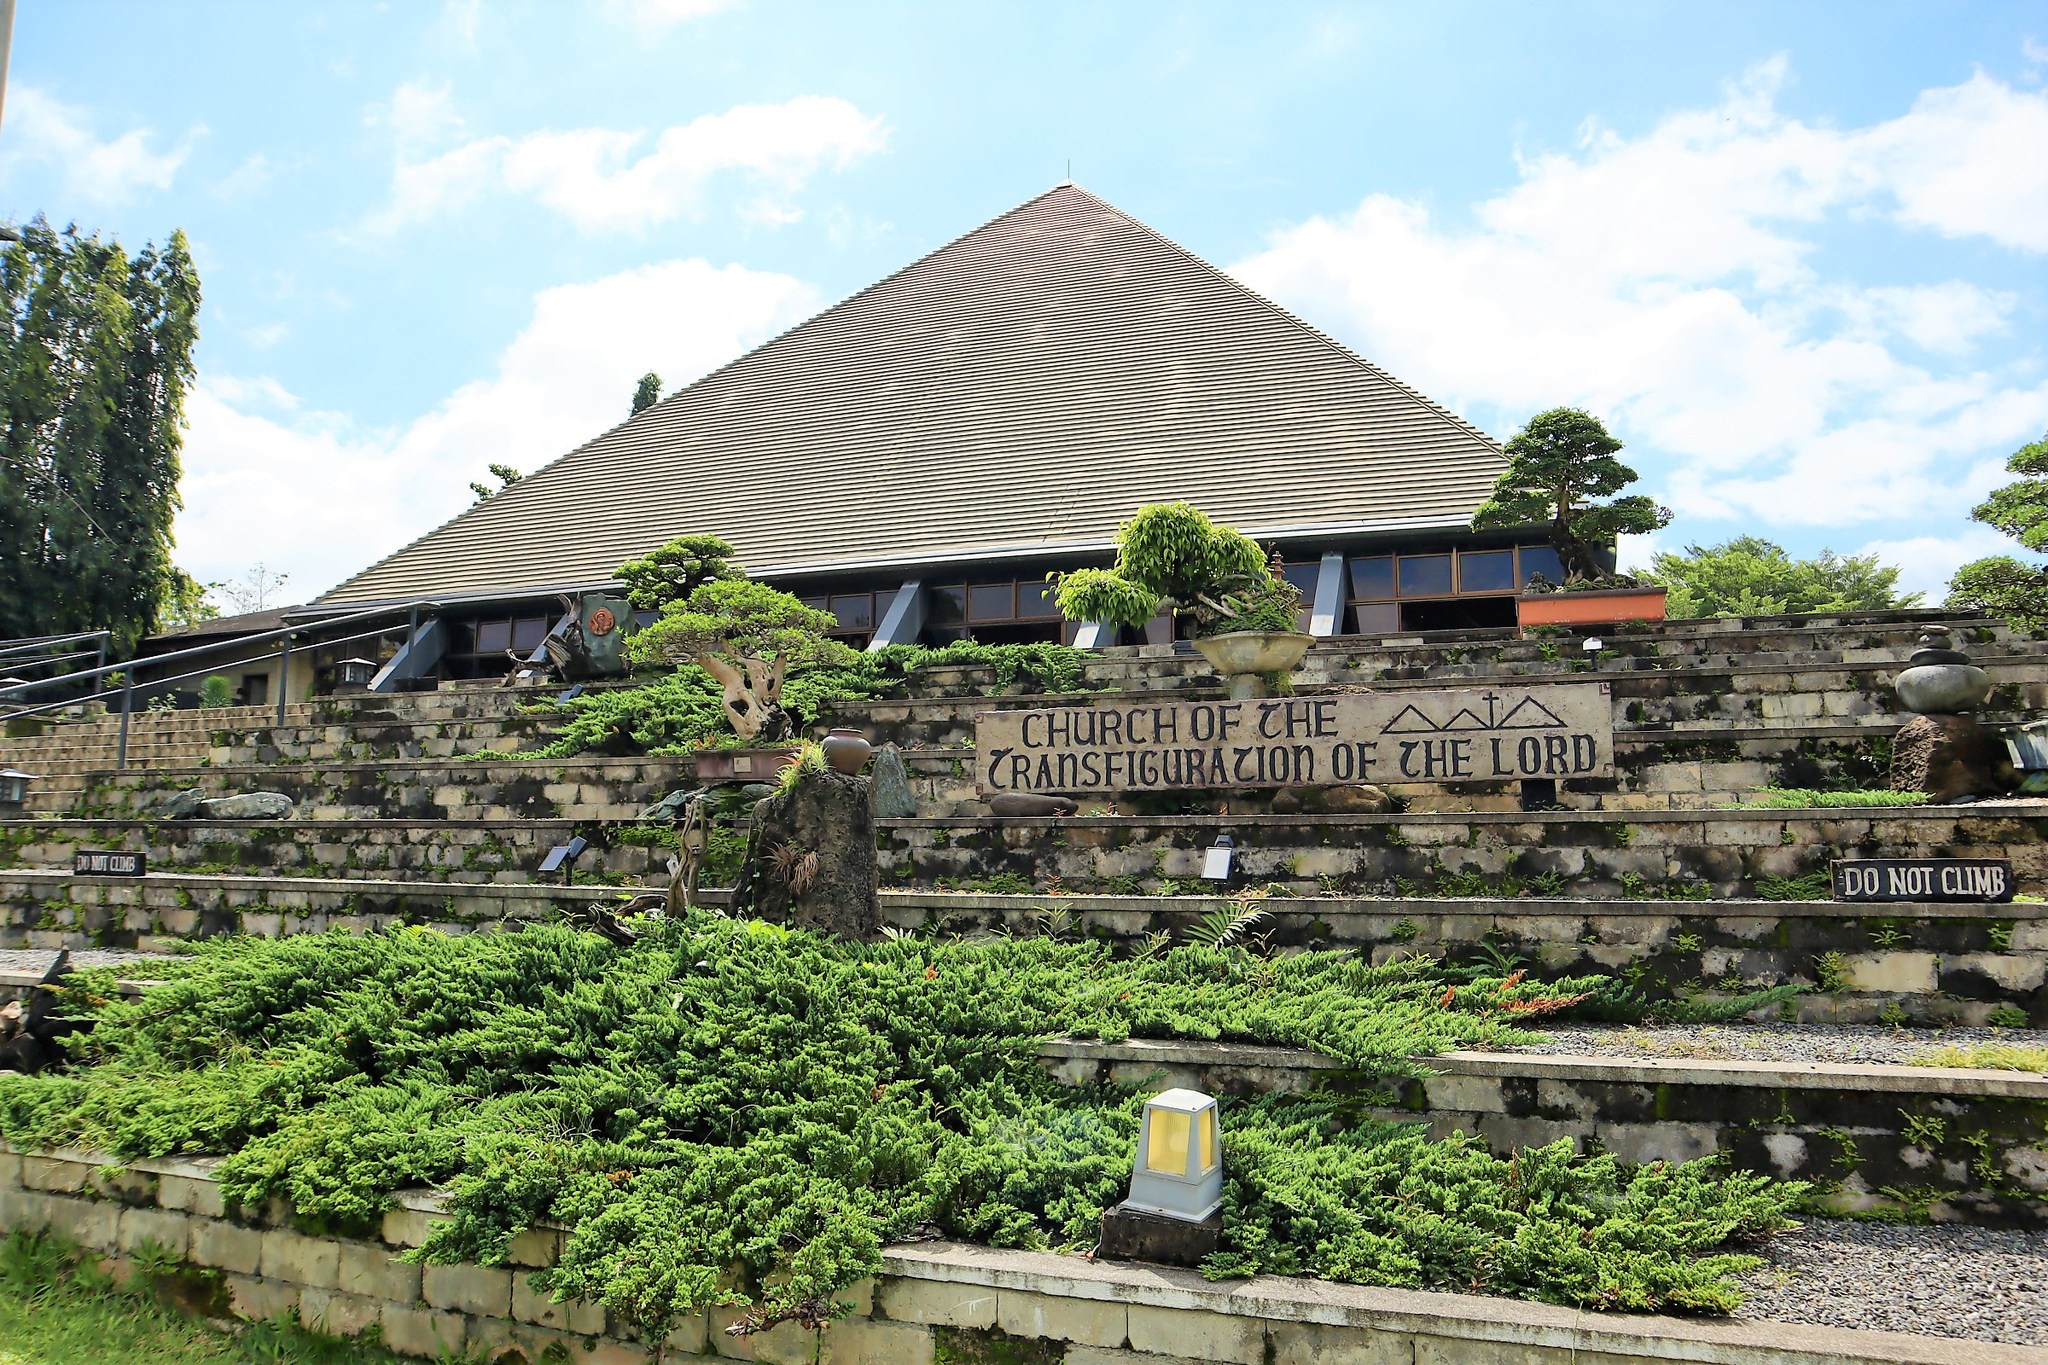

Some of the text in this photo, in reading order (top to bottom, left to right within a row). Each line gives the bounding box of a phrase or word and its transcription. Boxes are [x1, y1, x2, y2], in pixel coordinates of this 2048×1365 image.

[1021, 700, 1339, 748] CHURCH OF THE
[988, 733, 1597, 790] TRANSFIGURATION OF THE LORD
[76, 855, 136, 872] DO NOT CLIMB
[1843, 866, 2006, 896] DO NOT CLIMB
